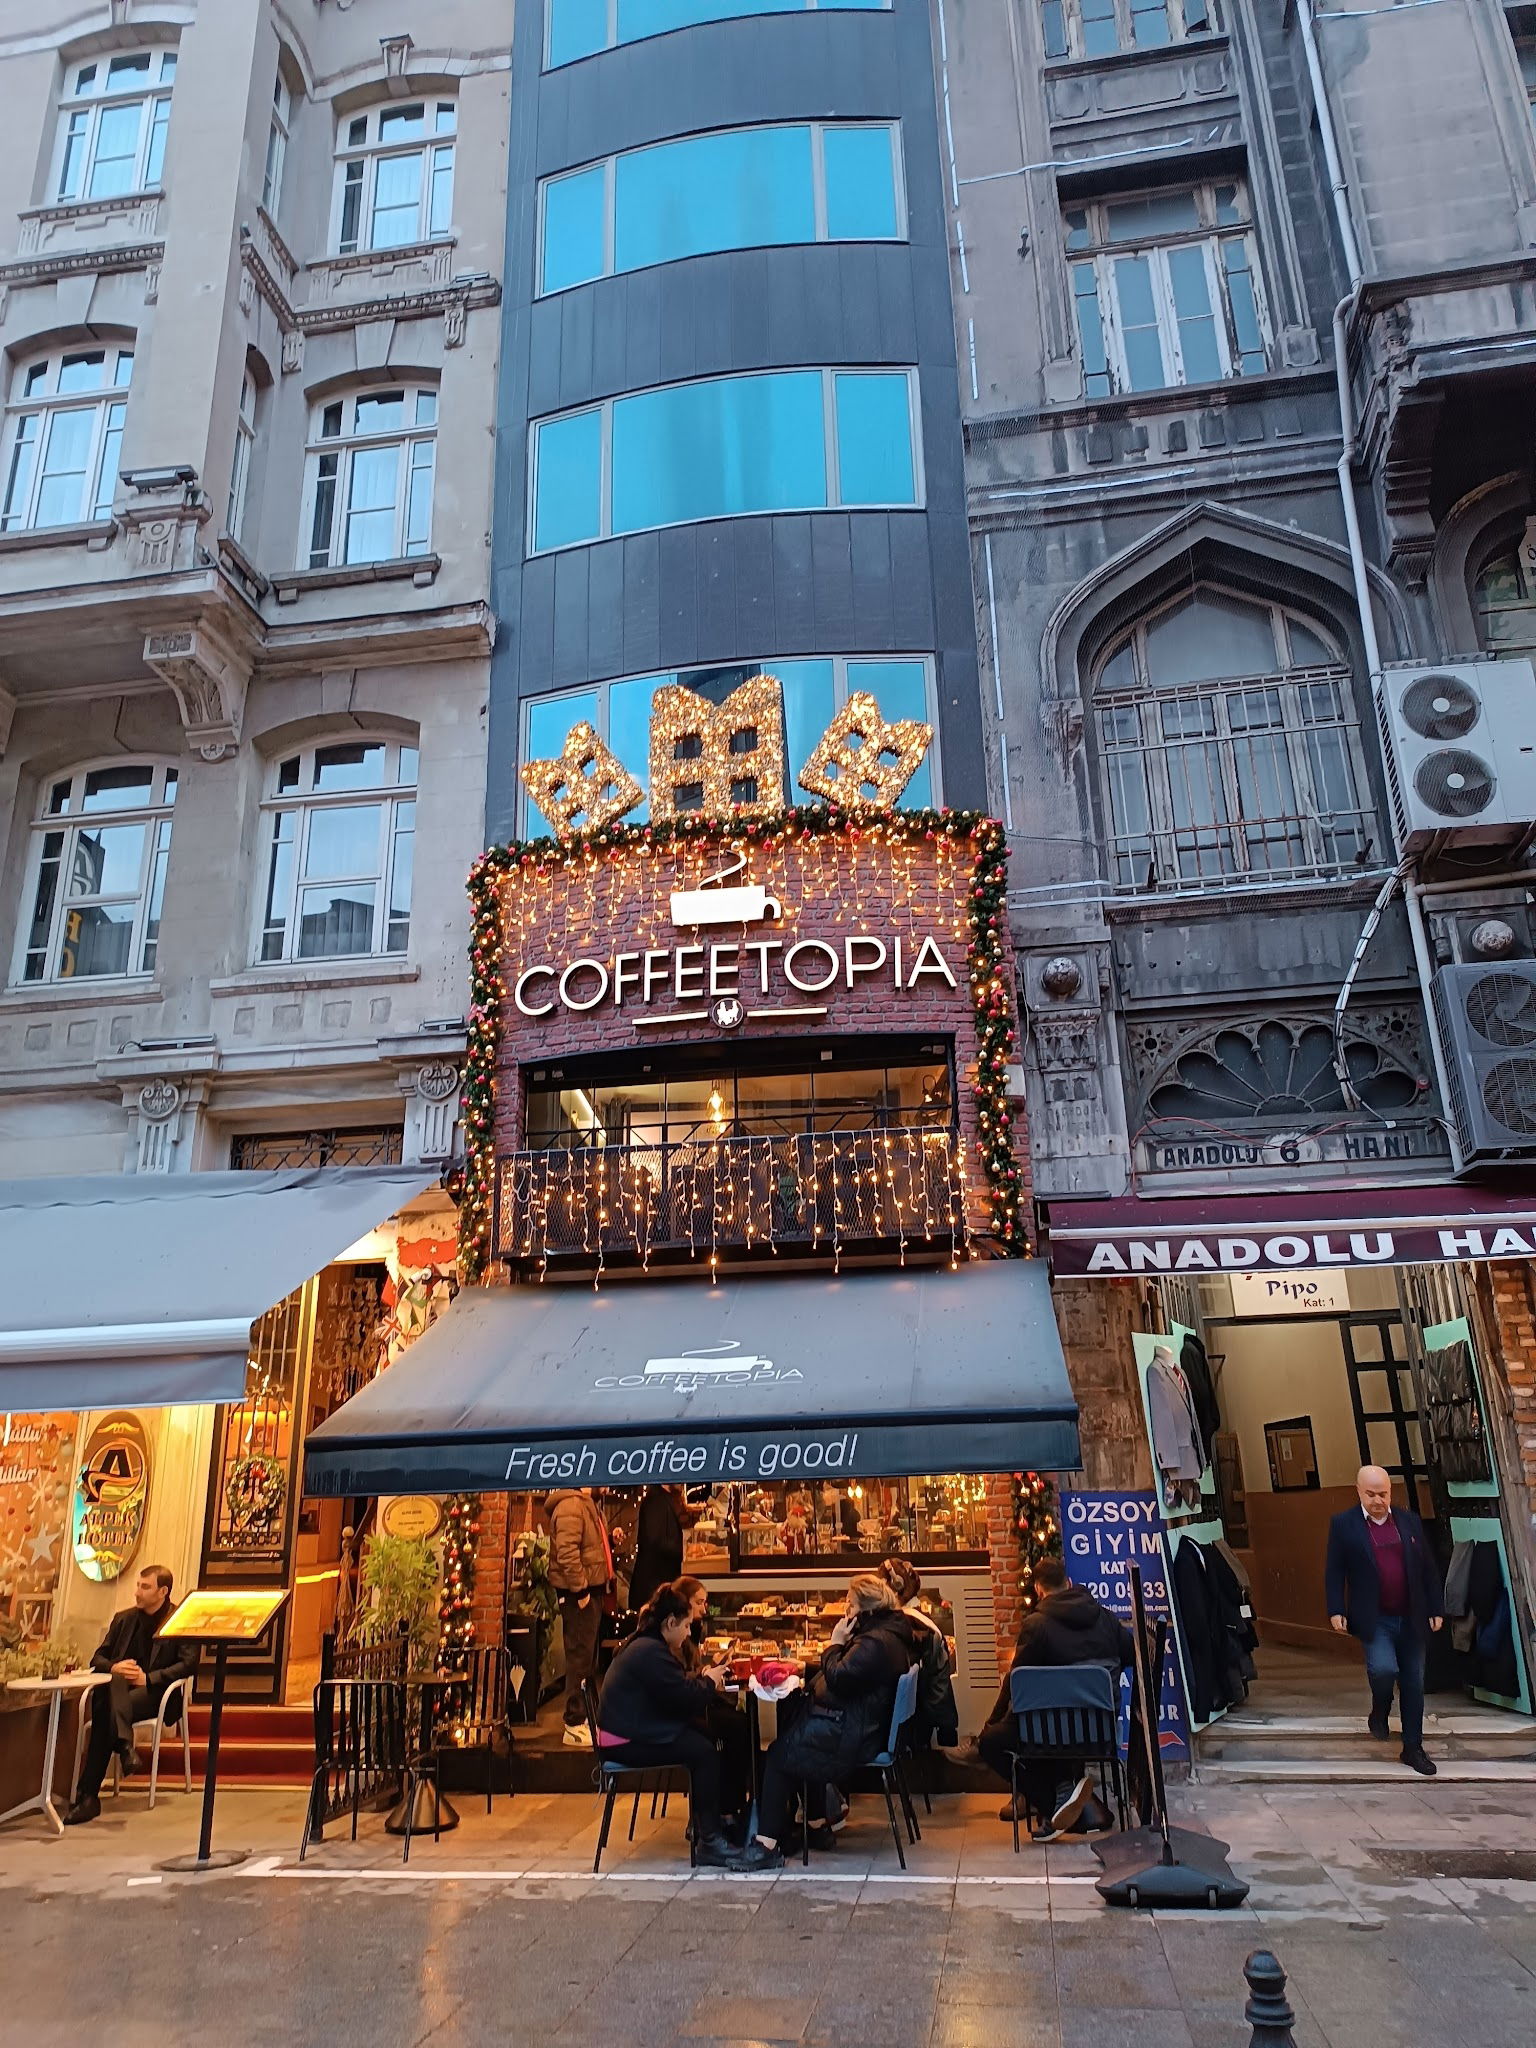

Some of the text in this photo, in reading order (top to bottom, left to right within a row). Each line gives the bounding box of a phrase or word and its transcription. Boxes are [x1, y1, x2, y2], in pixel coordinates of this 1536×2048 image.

[514, 936, 957, 1016] COFFEETOPIA
[1164, 1135, 1411, 1167] ANADOLU 6 HANI
[1086, 1226, 1536, 1271] ANADOLU HA
[1265, 1280, 1318, 1300] Pipo
[1303, 1297, 1335, 1308] Kat: 1
[594, 1368, 804, 1388] COFFEETOPIA
[505, 1434, 858, 1480] Fresh coffee is good!
[1067, 1497, 1157, 1523] ÖZSOY
[1070, 1528, 1161, 1555] GİYİM
[1100, 1561, 1126, 1575] KAT
[1079, 1581, 1110, 1599] 20
[1143, 1581, 1166, 1599] 33
